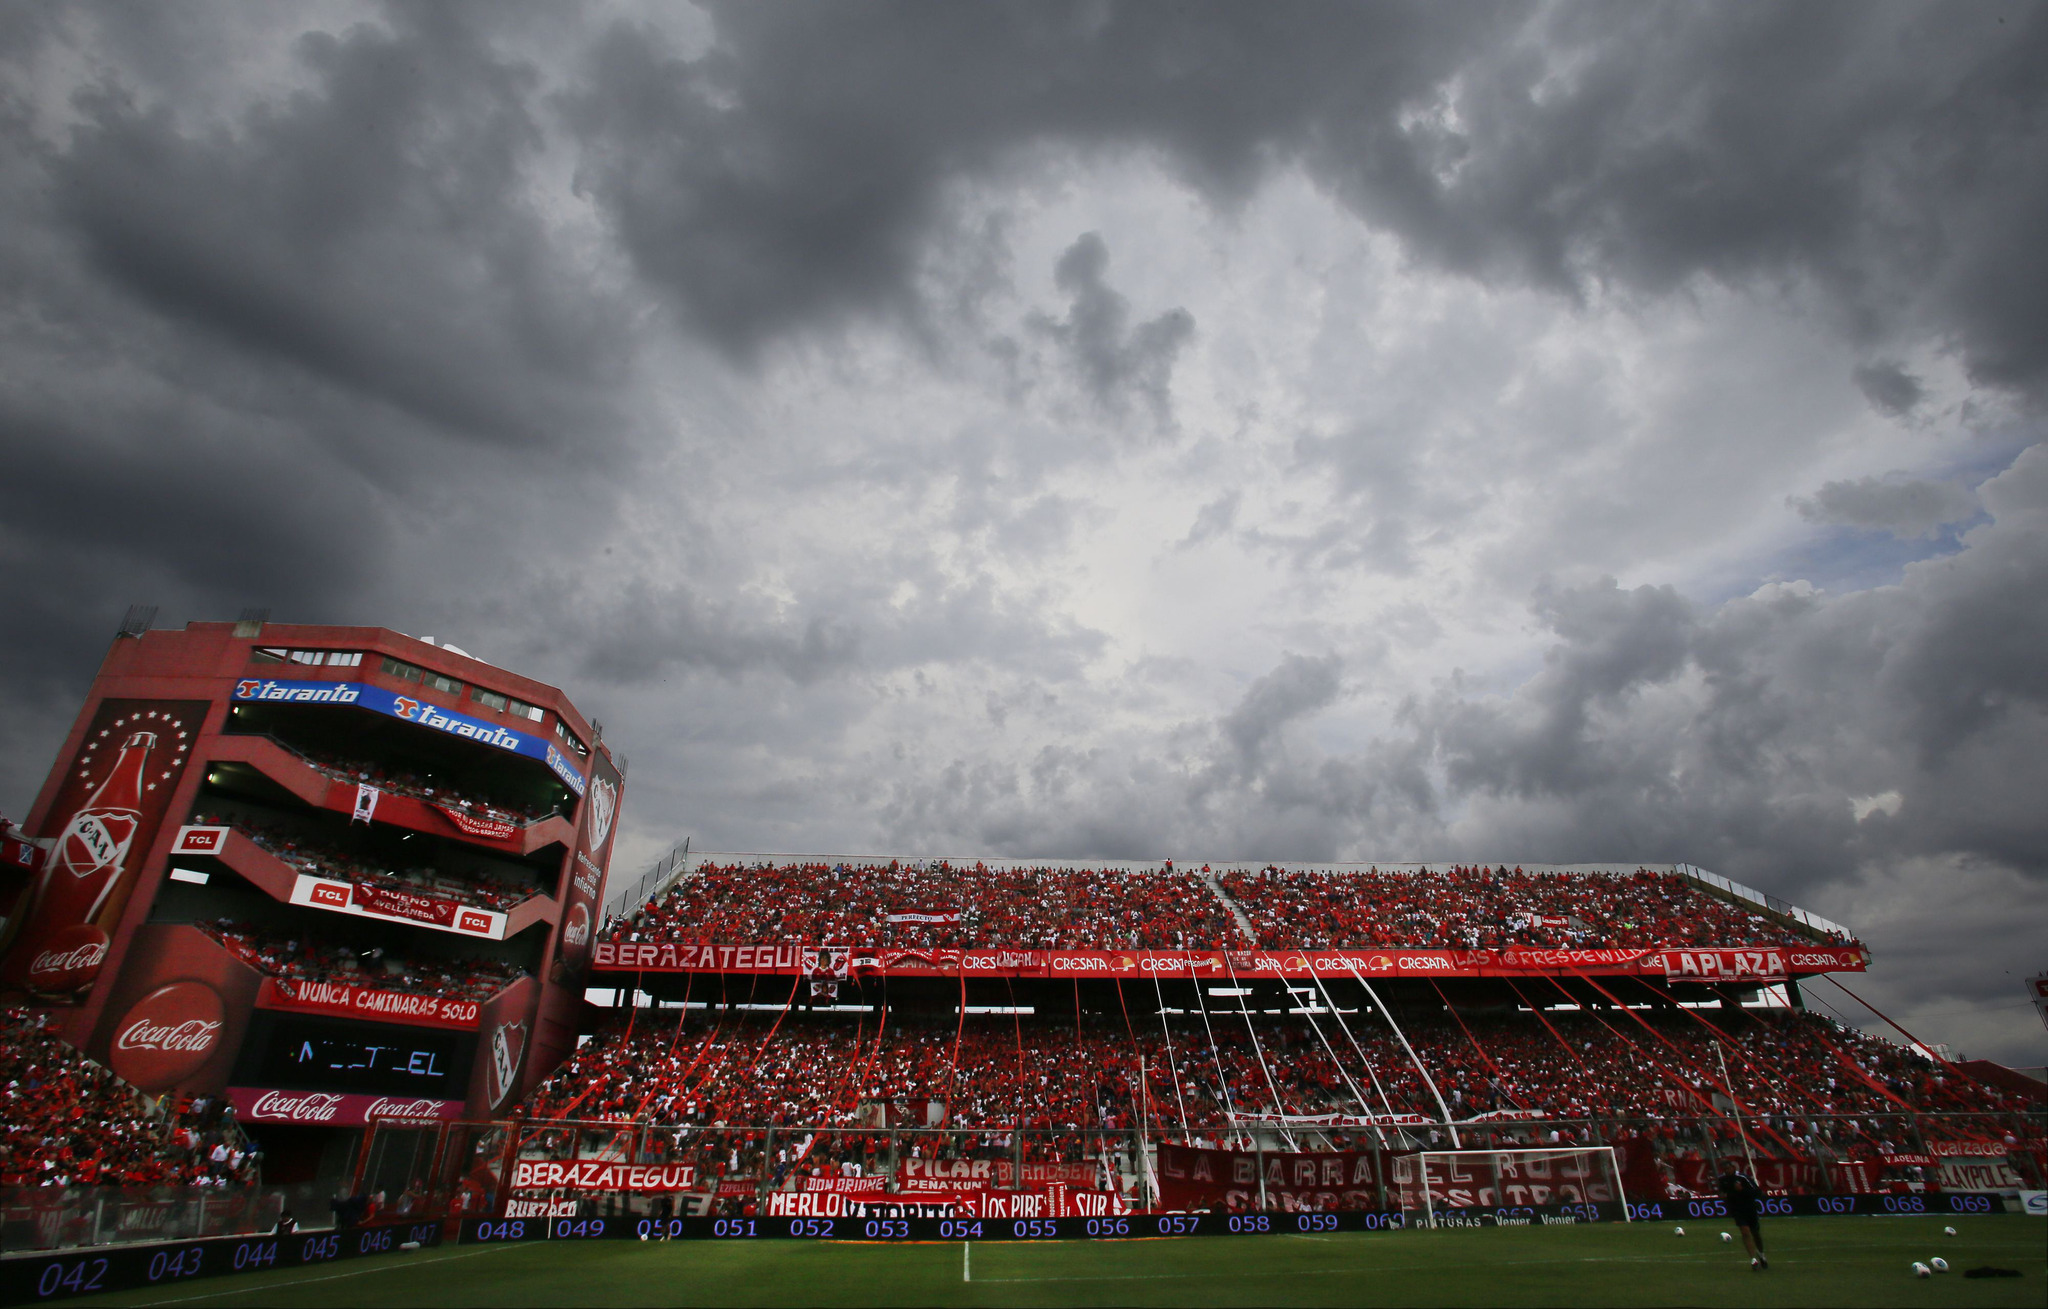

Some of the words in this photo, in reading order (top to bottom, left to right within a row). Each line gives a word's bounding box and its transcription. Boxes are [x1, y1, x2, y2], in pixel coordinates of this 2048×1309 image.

[256, 683, 360, 702] taranto
[417, 704, 520, 751] taranto
[553, 754, 585, 796] taranto
[188, 836, 213, 845] TCL
[574, 871, 596, 900] infierno
[317, 889, 343, 901] TCL
[373, 899, 435, 920] AVELLANEDA
[464, 917, 488, 928] TCL
[31, 943, 105, 974] Coca-Cola
[594, 943, 800, 968] BERAZATEGUI
[1053, 957, 1108, 971] CRESATA
[1315, 957, 1368, 971] CRESATA
[1399, 957, 1450, 971] CRESATA
[1791, 953, 1839, 966] CRESATA
[298, 981, 350, 1006] NUNCA
[355, 991, 438, 1016] CAMINARAS
[441, 1003, 477, 1021] SOLO
[118, 1018, 223, 1053] Coca-Cola
[252, 1090, 344, 1121] Coca-Cola
[516, 1163, 694, 1188] BERAZATEGUI
[906, 1160, 991, 1179] PILAR
[1164, 1151, 1214, 1183] LA
[1233, 1156, 1373, 1187] BARRA
[1391, 1153, 1474, 1185] DEL
[806, 1177, 834, 1192] DON
[835, 1176, 886, 1192] ORIONE
[770, 1192, 840, 1217] MERLO
[982, 1193, 1006, 1218] LOS
[1076, 1193, 1107, 1217] SUR
[1626, 1203, 1663, 1219] 064
[1688, 1200, 1727, 1217] 065
[1817, 1197, 1856, 1213] 067
[1884, 1196, 1926, 1212] 068
[1951, 1196, 1992, 1212] 069
[557, 1219, 605, 1238] 049
[713, 1219, 758, 1237] 051
[790, 1219, 835, 1237] 052
[865, 1220, 909, 1238] 053
[940, 1220, 984, 1238] 054
[1013, 1220, 1057, 1237] 055
[1086, 1218, 1130, 1236] 056
[1158, 1217, 1200, 1234] 057
[1229, 1215, 1271, 1233] 058
[1298, 1214, 1339, 1232] 059
[1416, 1217, 1482, 1230] PINTURAS
[1495, 1215, 1531, 1227] Venier
[1541, 1213, 1576, 1225] Venier
[409, 1224, 436, 1244] 047
[477, 1221, 525, 1241] 048
[302, 1234, 341, 1261] 045
[360, 1229, 391, 1253] 046
[149, 1247, 204, 1281] 043
[233, 1242, 278, 1270] 044
[38, 1258, 109, 1296] 042
